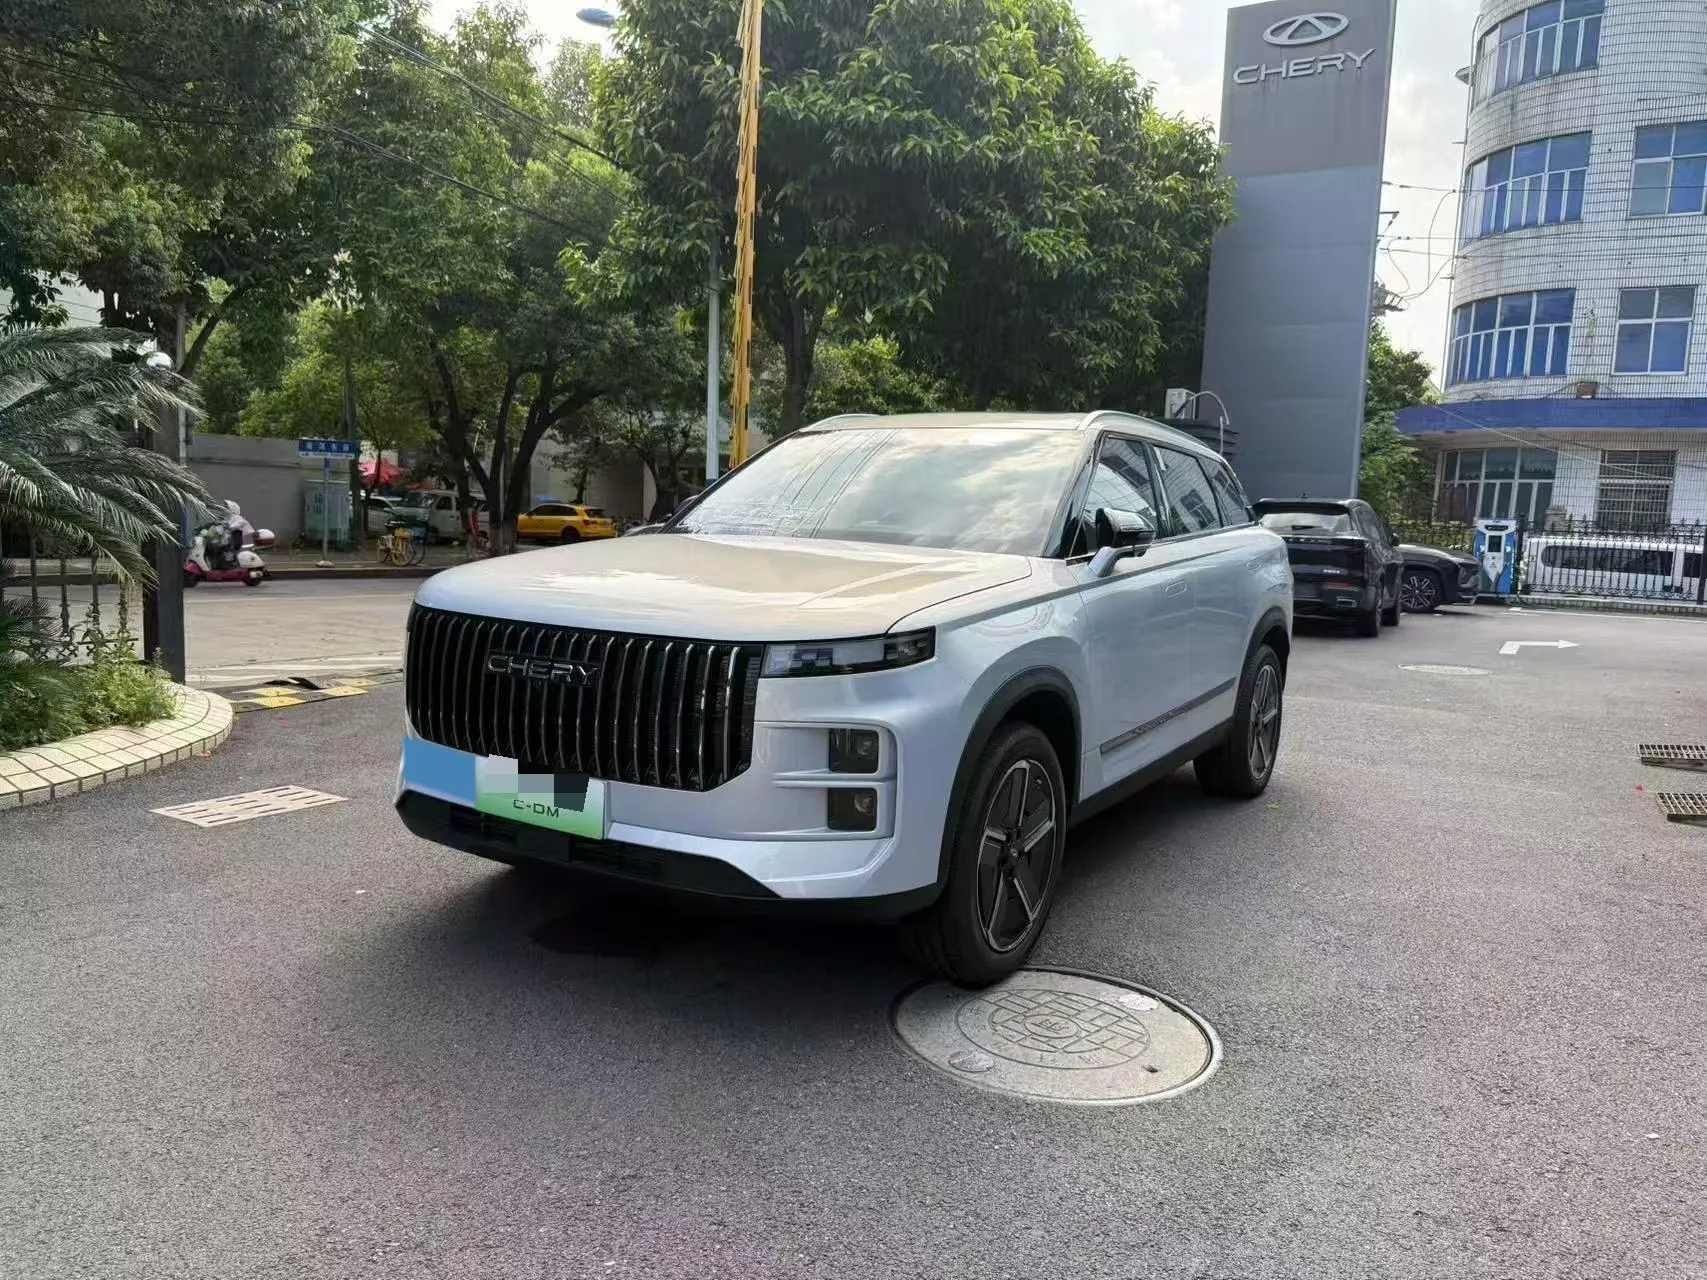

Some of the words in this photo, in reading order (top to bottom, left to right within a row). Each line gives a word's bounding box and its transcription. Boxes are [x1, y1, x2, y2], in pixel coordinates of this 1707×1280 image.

[1233, 48, 1376, 84] CHERY
[488, 656, 598, 685] CHERY
[513, 799, 559, 818] C-DM
